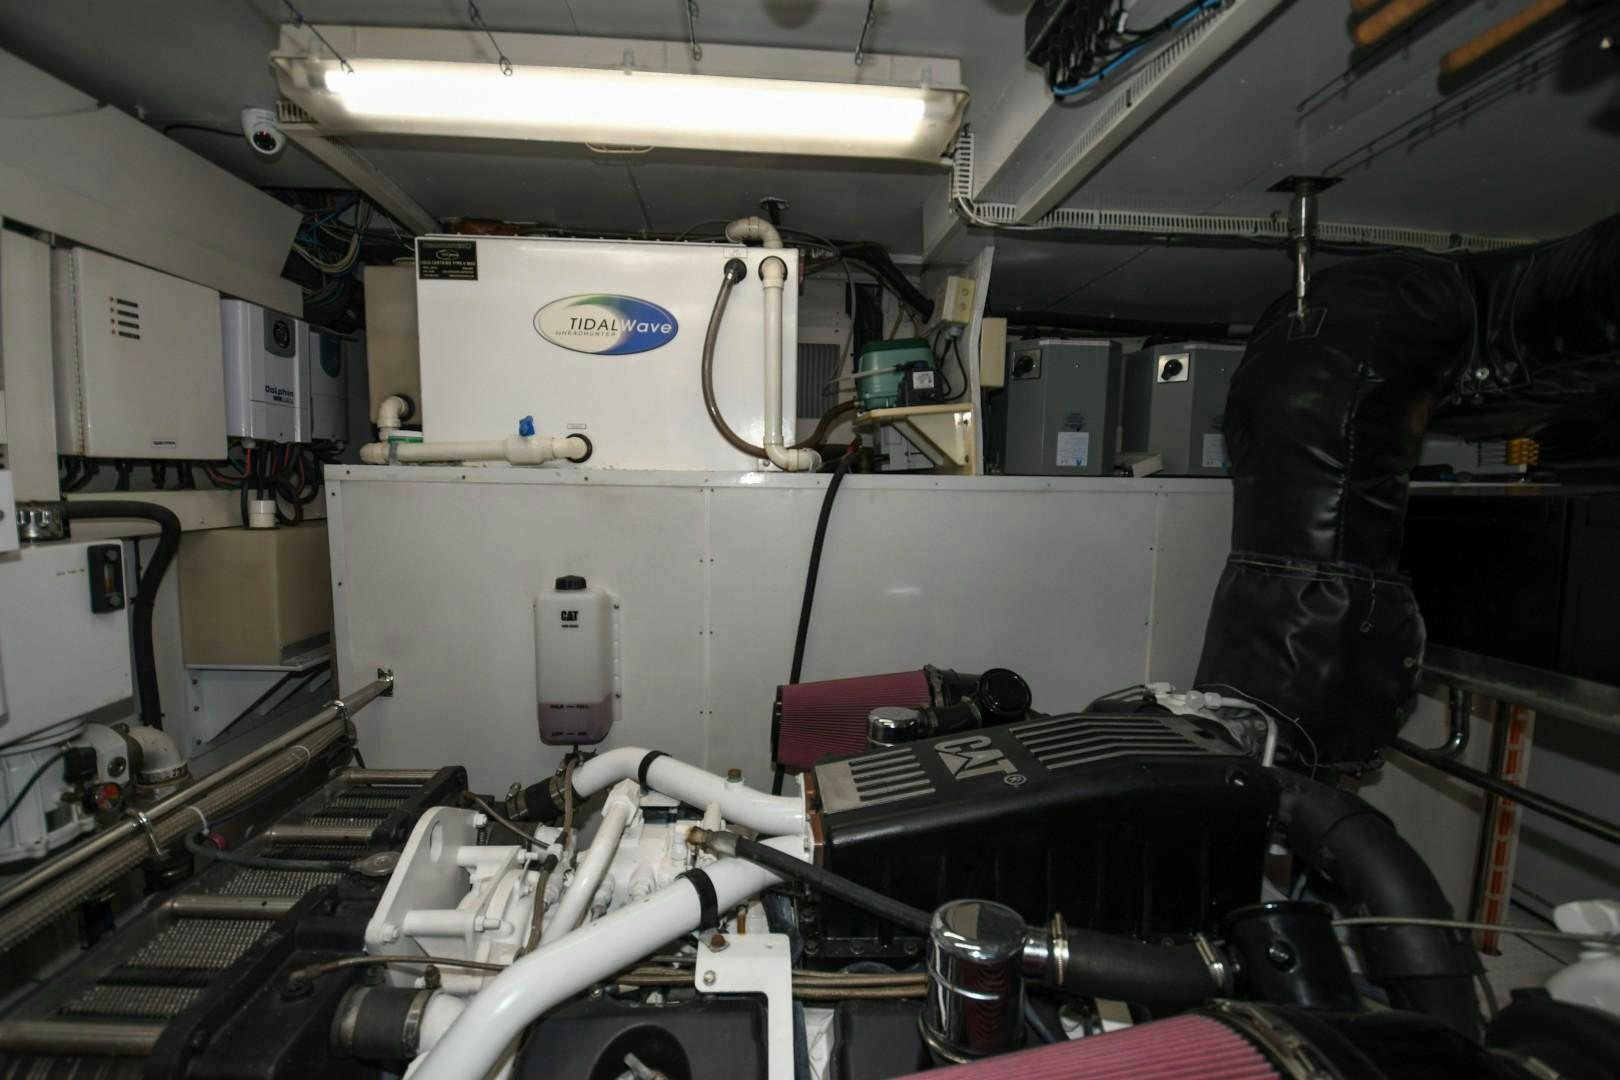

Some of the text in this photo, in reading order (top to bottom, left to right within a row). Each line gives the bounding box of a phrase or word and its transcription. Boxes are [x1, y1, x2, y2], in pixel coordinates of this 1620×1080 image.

[265, 385, 294, 398] Dolphin
[560, 610, 579, 621] CAT
[934, 735, 1019, 780] CAT
